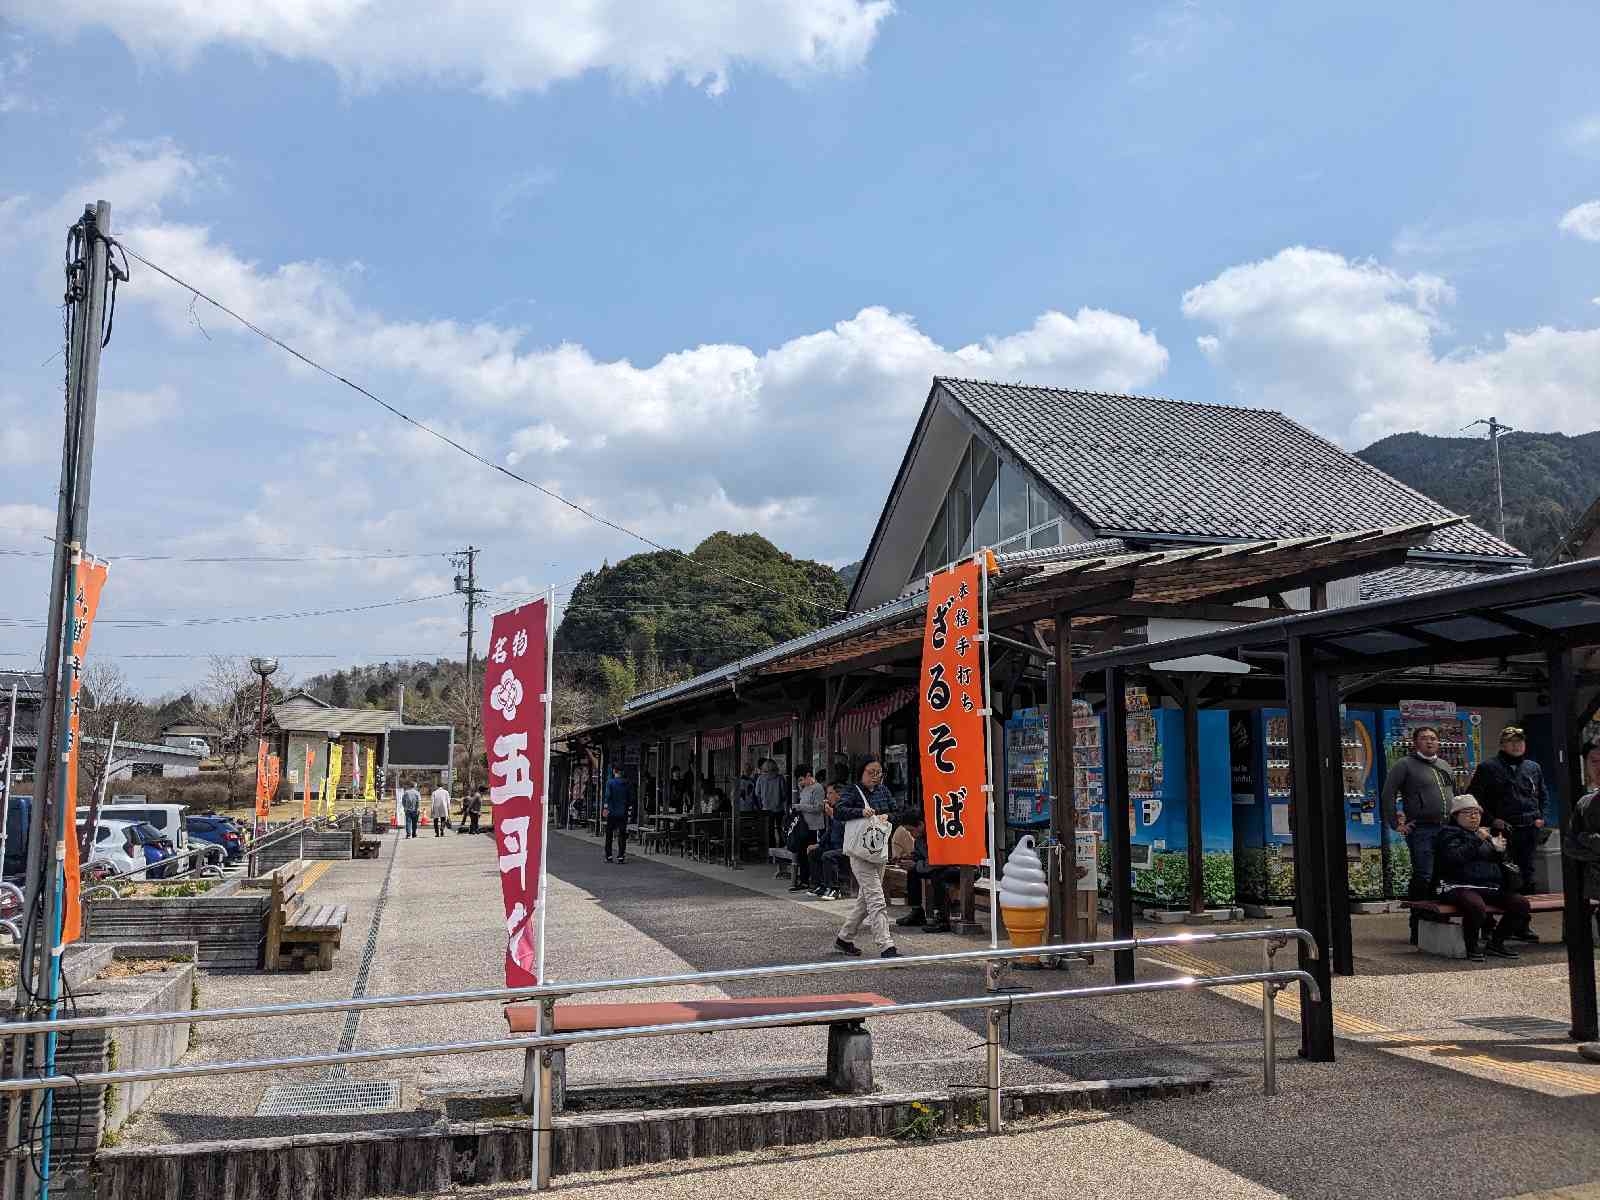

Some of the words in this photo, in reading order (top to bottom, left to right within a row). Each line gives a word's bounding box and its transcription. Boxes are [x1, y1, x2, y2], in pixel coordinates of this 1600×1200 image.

[492, 628, 528, 664] 名物
[956, 581, 974, 712] 本格手打ち
[927, 596, 967, 838] ざるそば
